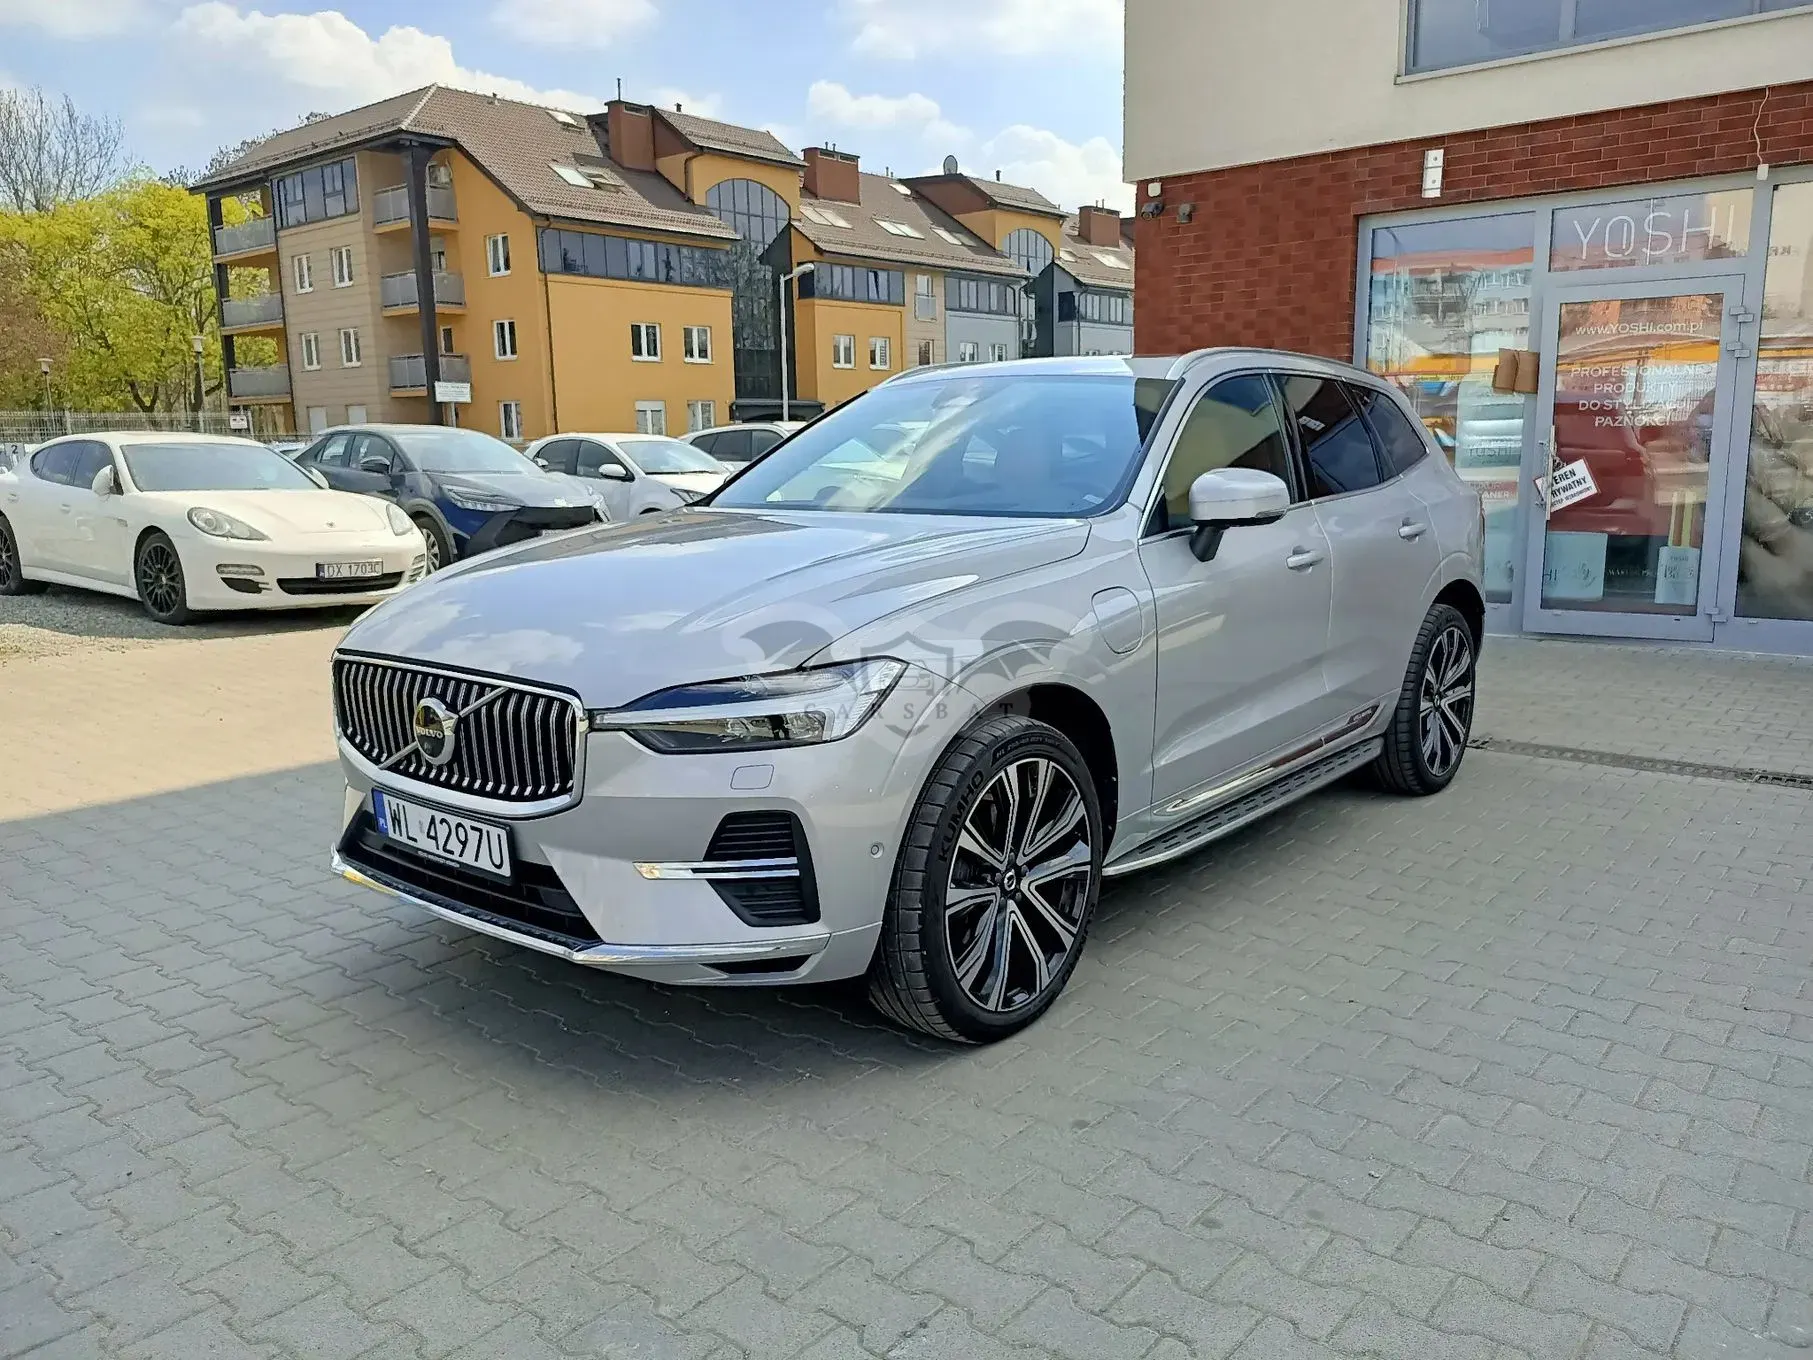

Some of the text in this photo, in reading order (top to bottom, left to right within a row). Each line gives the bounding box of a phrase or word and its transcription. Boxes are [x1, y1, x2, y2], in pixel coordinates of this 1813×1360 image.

[1573, 204, 1735, 261] YOSHI
[1594, 381, 1678, 394] PRODUKTY
[1578, 400, 1600, 411] DO
[1552, 468, 1577, 487] EREN
[1550, 476, 1587, 499] RYWATNY
[327, 565, 343, 577] DX
[415, 725, 444, 739] VOLVO
[388, 799, 504, 870] WL 4297U
